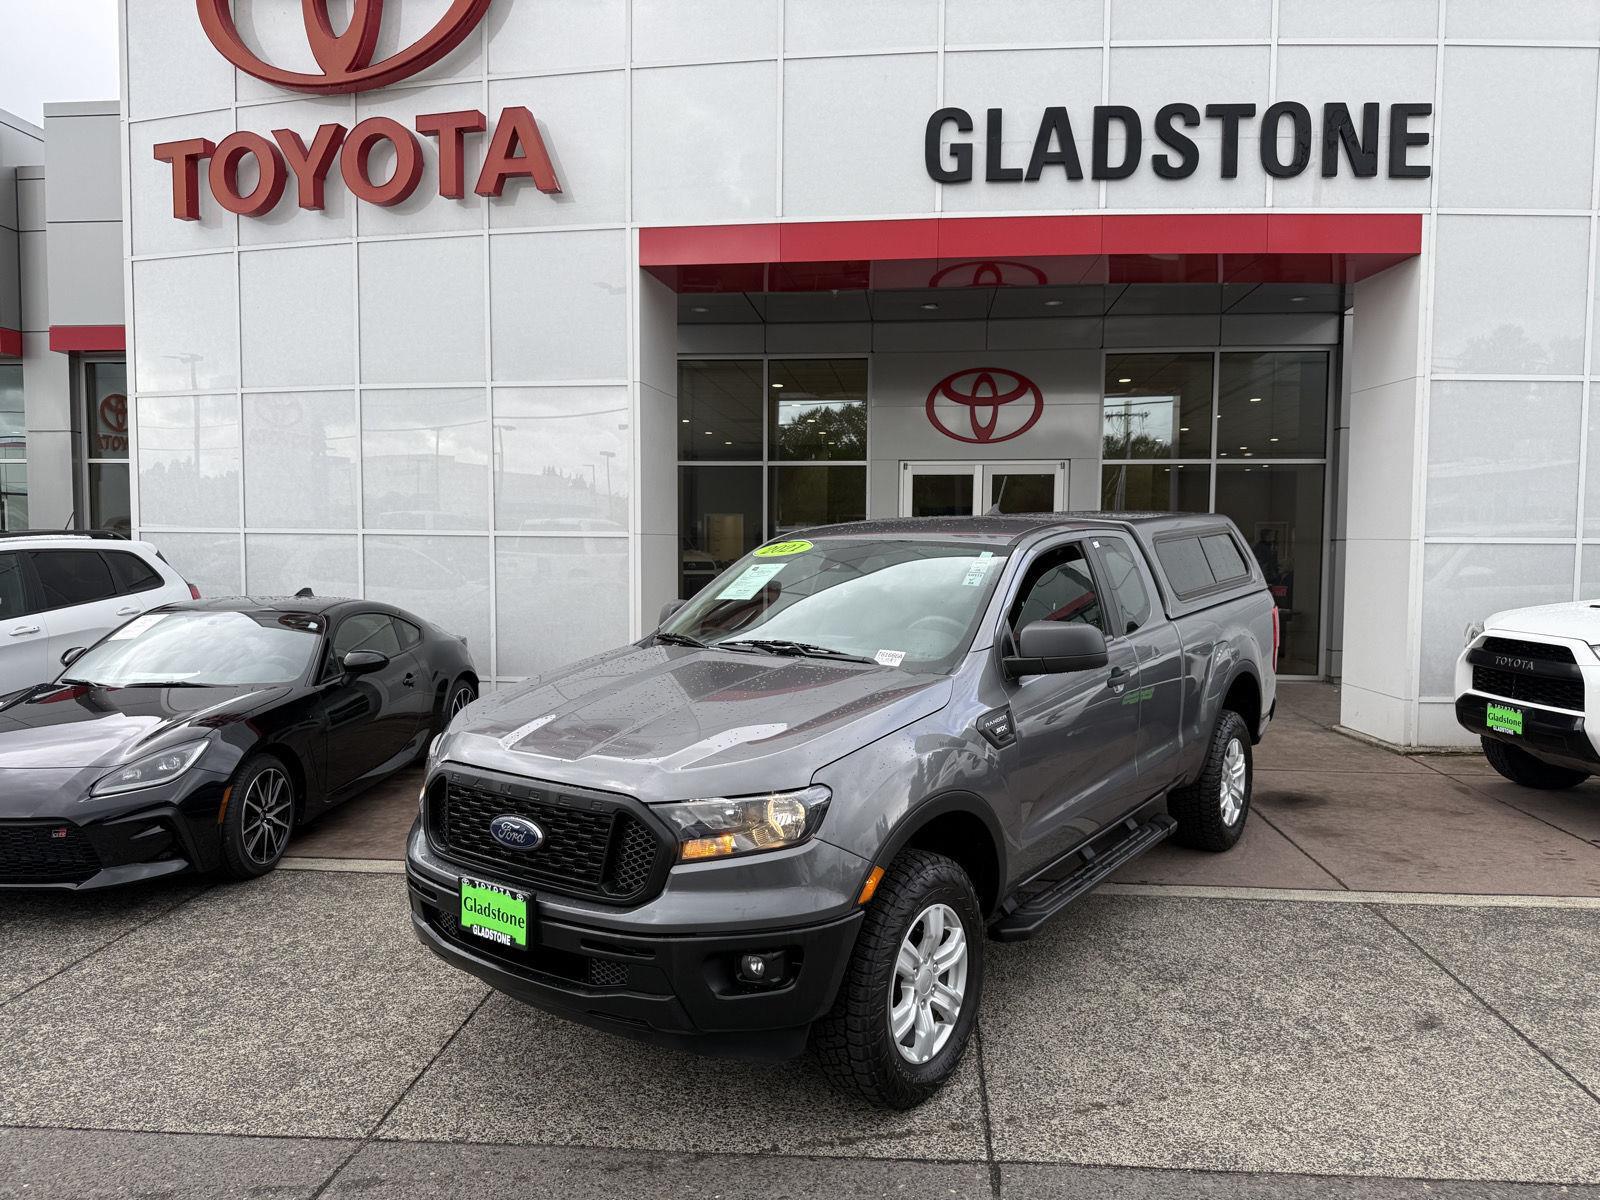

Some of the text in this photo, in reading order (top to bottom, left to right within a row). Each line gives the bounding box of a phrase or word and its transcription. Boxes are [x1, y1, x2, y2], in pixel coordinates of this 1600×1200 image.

[925, 101, 1432, 184] GLADSTONE
[154, 106, 562, 221] TOYOTA
[1495, 655, 1534, 670] TOYOTA
[985, 714, 1007, 728] RANGER
[996, 724, 1008, 734] STX
[1488, 712, 1521, 727] Gladstone
[451, 772, 604, 812] RANGER
[498, 821, 527, 844] Ford
[474, 881, 511, 897] TOYOTA
[463, 896, 525, 929] Gladstone
[472, 924, 511, 946] GLADSTONE
